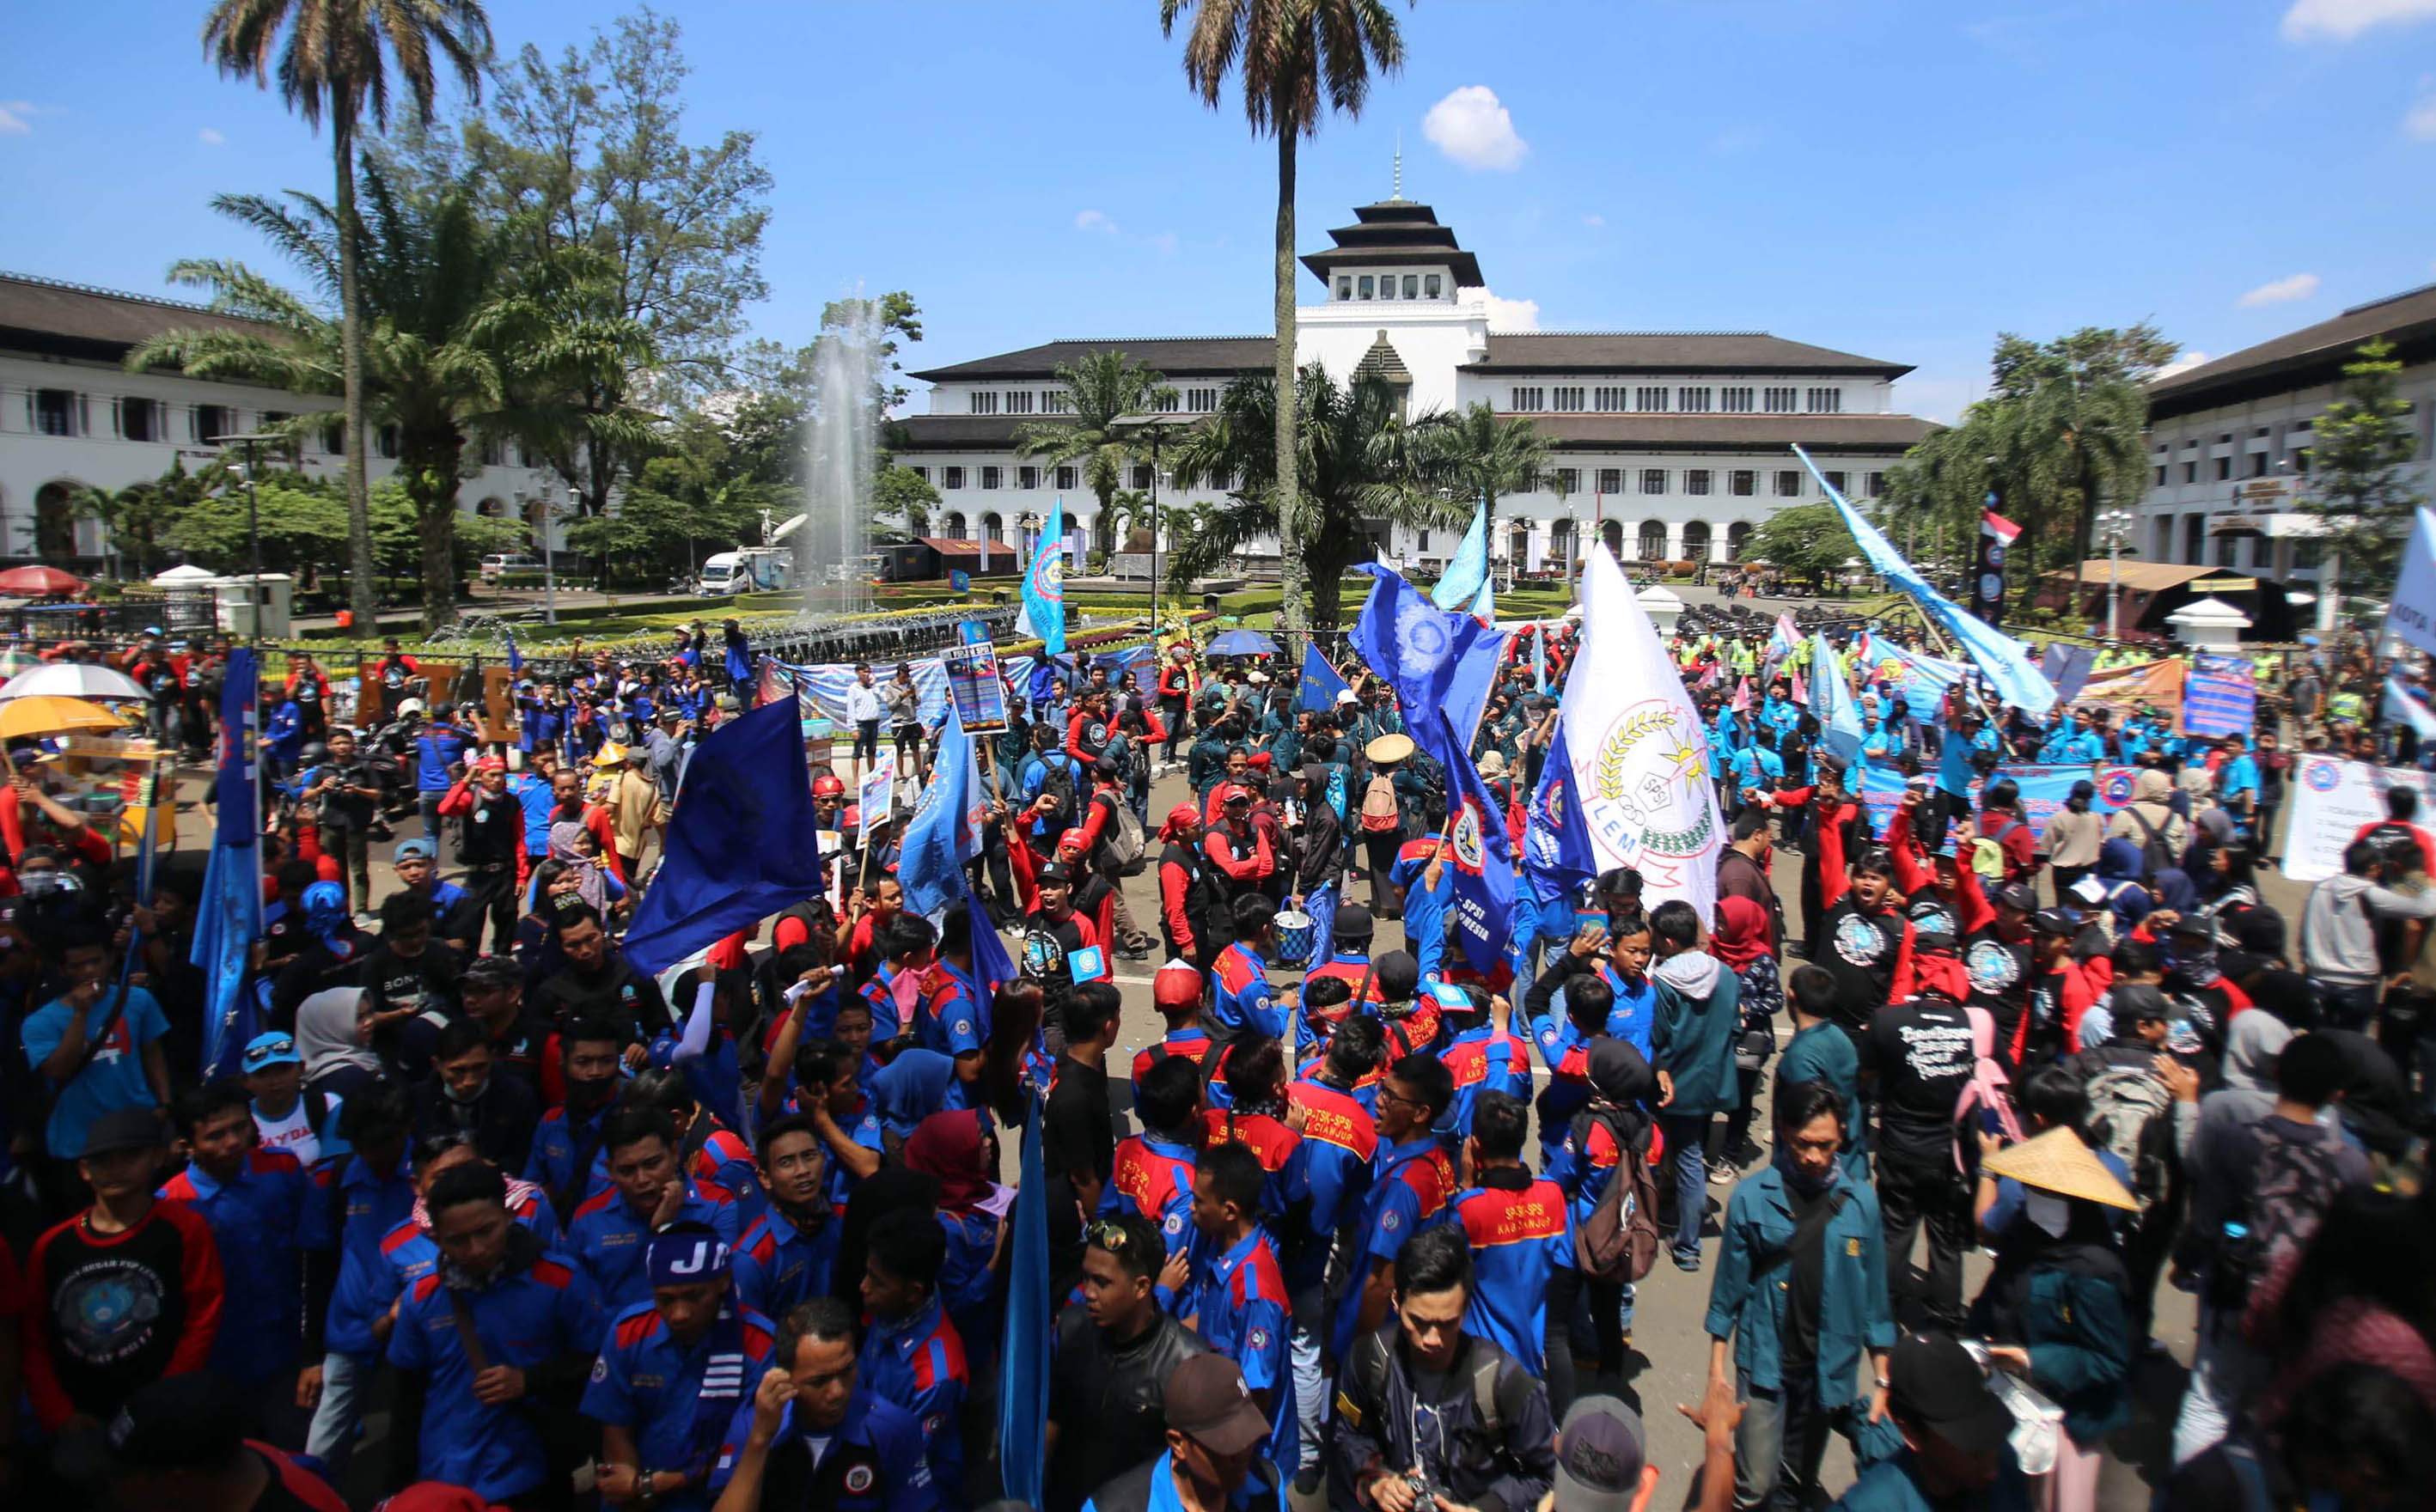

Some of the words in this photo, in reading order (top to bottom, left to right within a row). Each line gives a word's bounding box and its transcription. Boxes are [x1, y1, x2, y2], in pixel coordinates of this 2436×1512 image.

[1644, 778, 1669, 806] SPSI
[1594, 805, 1636, 853] LEM
[1462, 899, 1486, 920] SPSI
[1458, 907, 1489, 942] ONESIA
[1307, 1108, 1352, 1131] P-TSK-SPSI
[1315, 1123, 1353, 1141] CIANJUR
